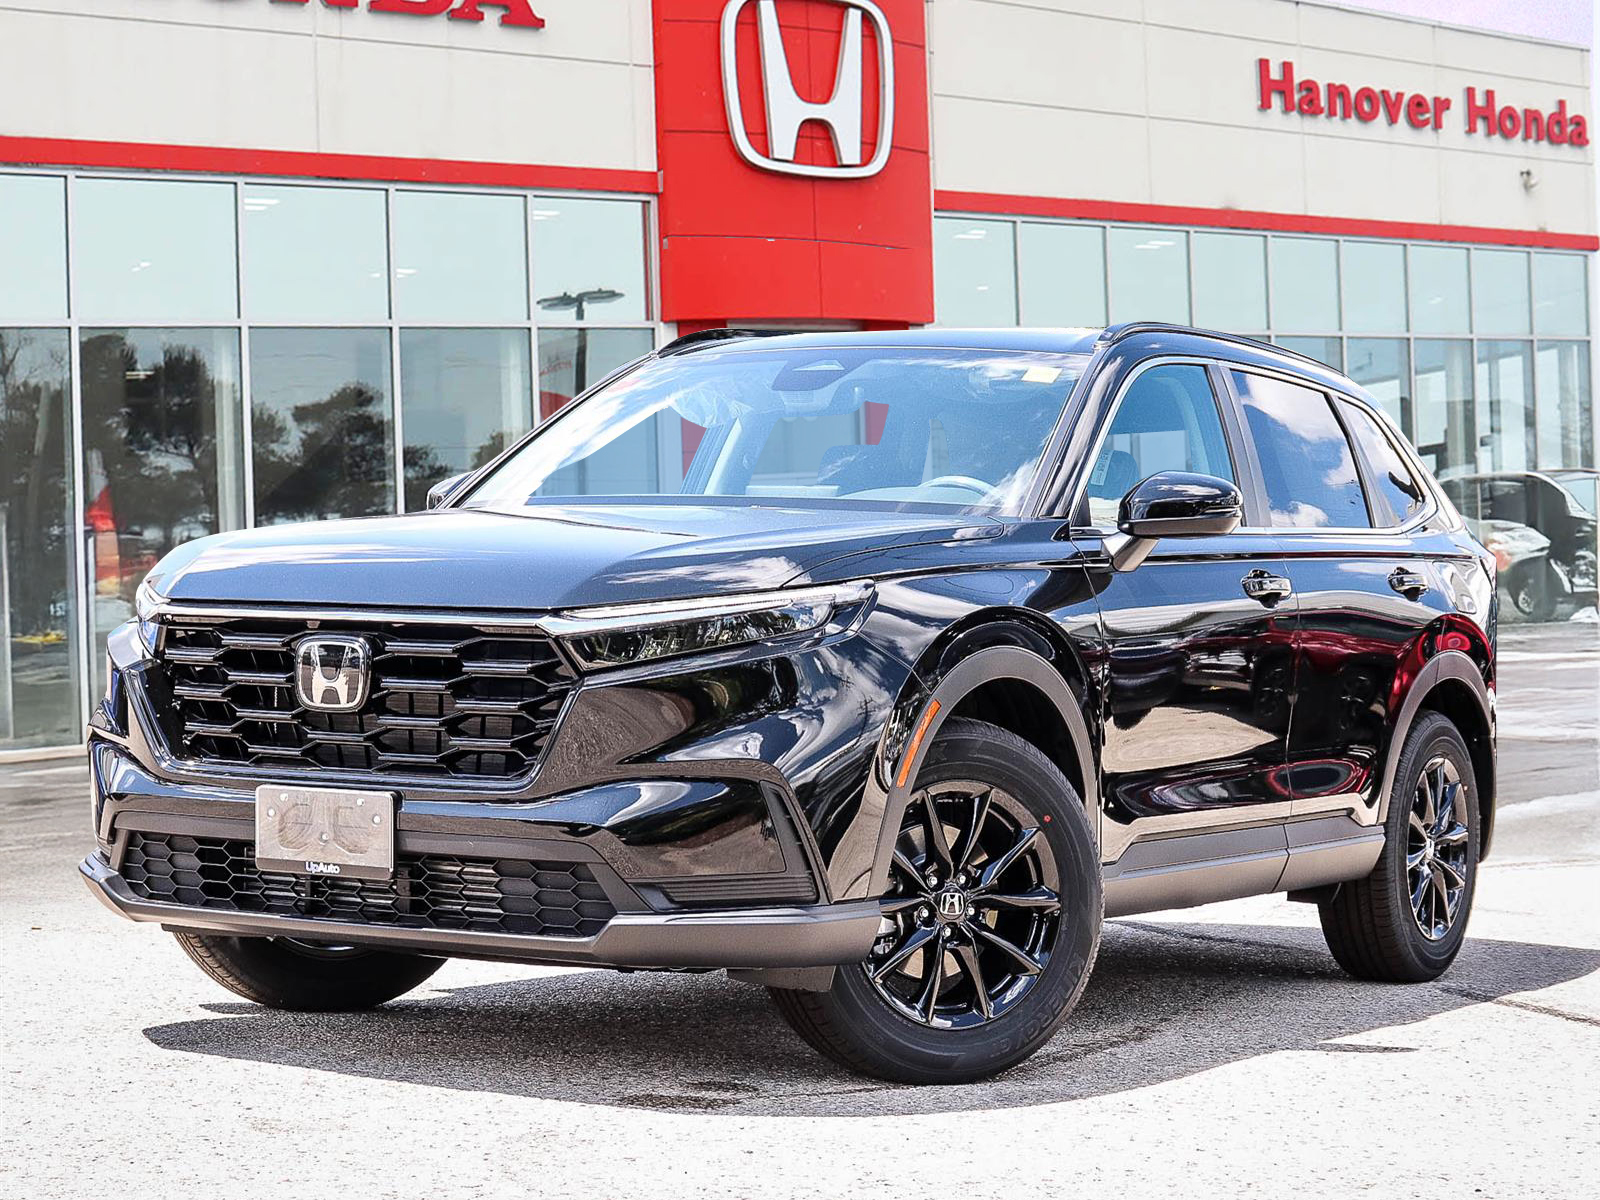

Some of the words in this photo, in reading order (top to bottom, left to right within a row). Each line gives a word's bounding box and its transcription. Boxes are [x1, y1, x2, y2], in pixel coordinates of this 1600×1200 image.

[1257, 58, 1451, 130] Hanover
[1464, 86, 1590, 147] Honda
[305, 861, 340, 874] UpAuto
